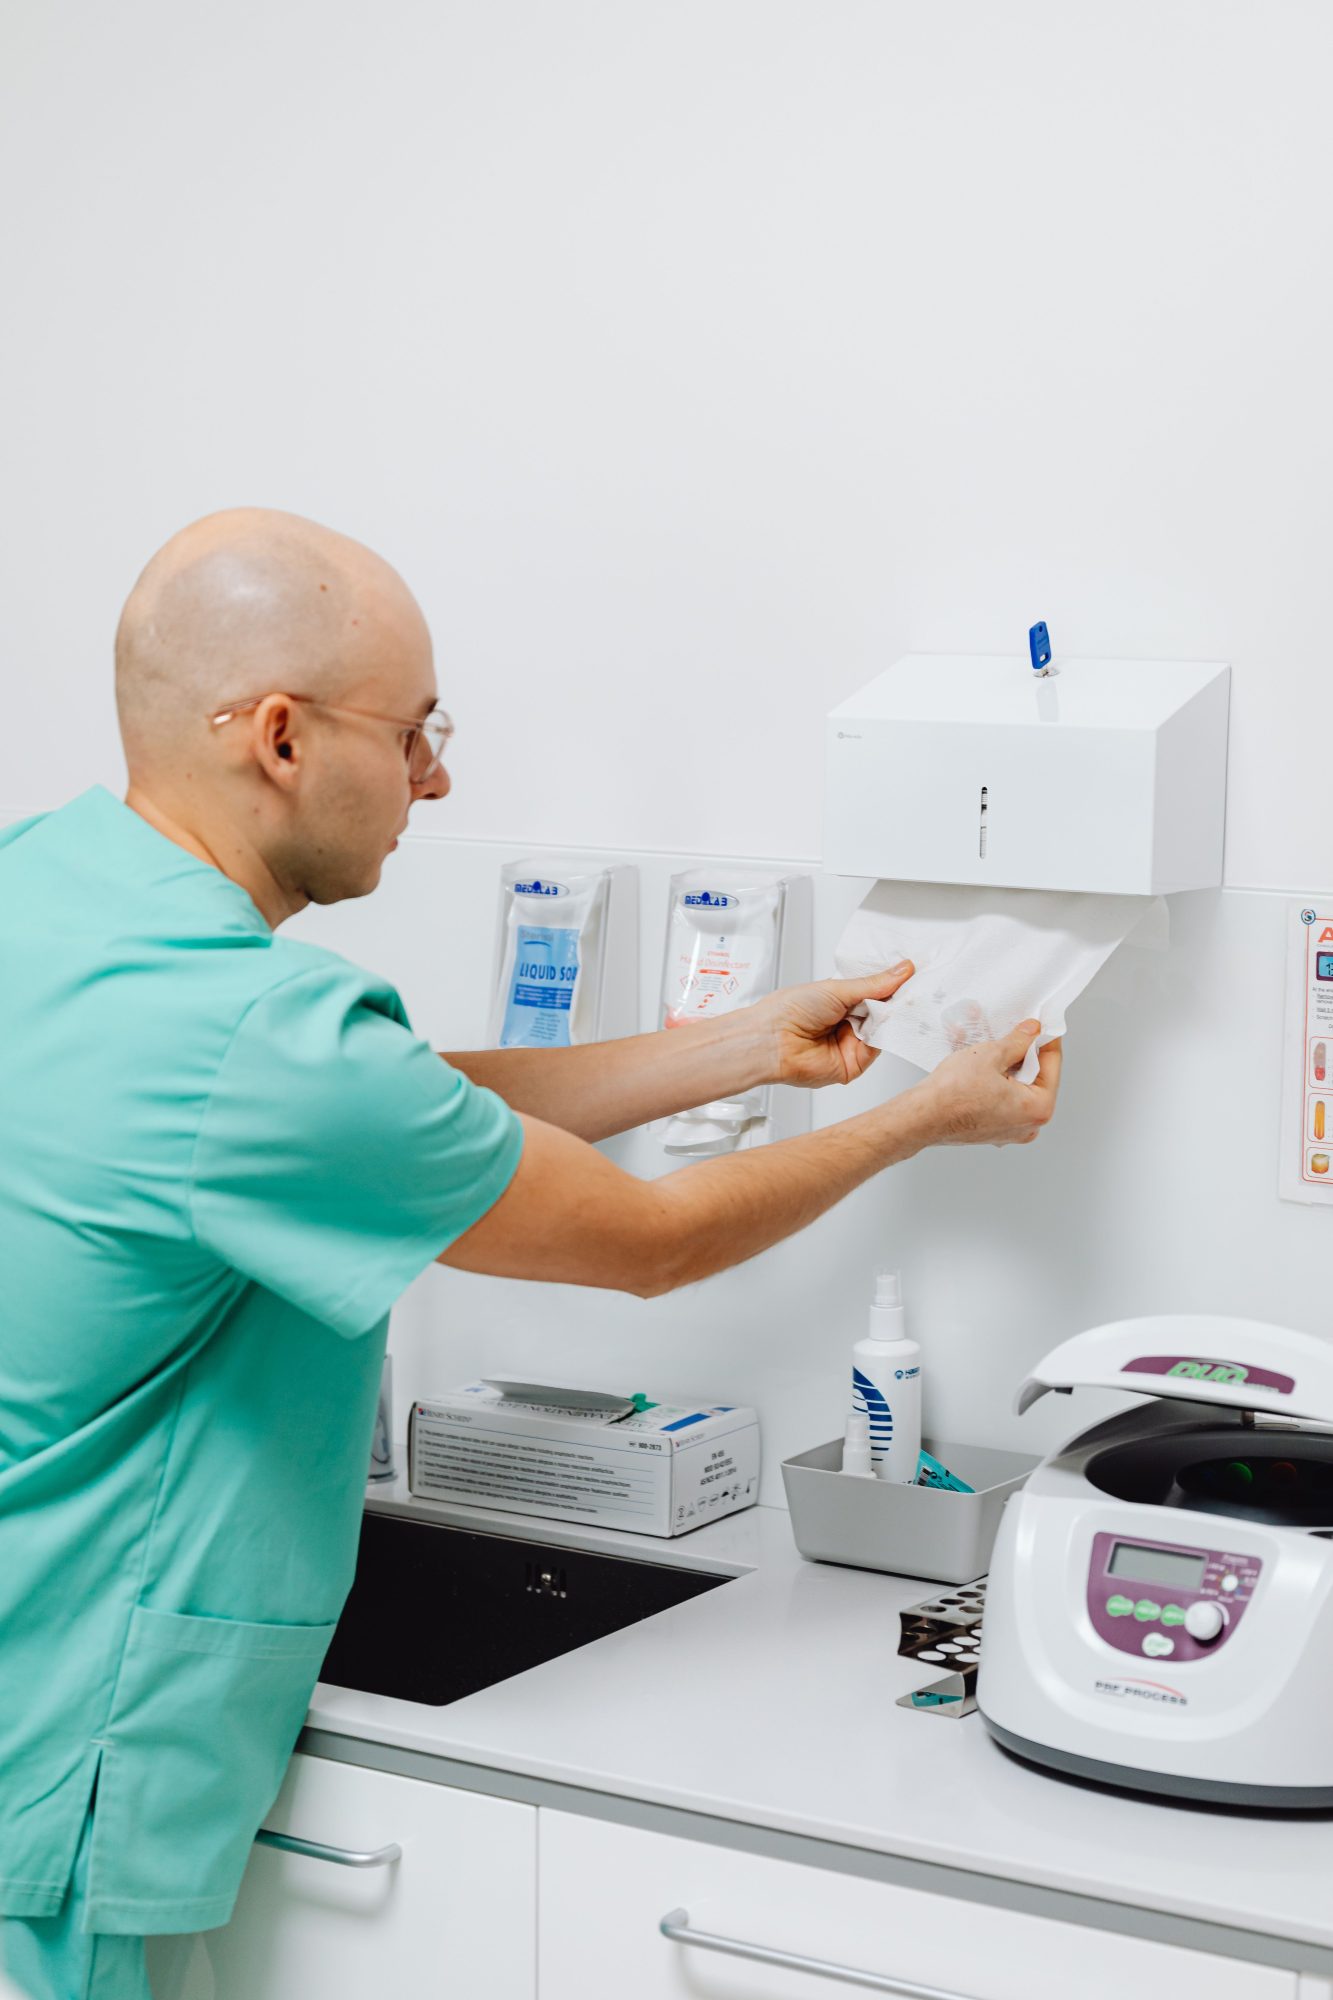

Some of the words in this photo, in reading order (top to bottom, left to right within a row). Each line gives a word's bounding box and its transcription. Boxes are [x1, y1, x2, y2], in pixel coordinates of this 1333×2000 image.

[519, 962, 557, 981] LIQUID
[1167, 1361, 1248, 1384] DUO
[1124, 1686, 1188, 1706] PROCESS
